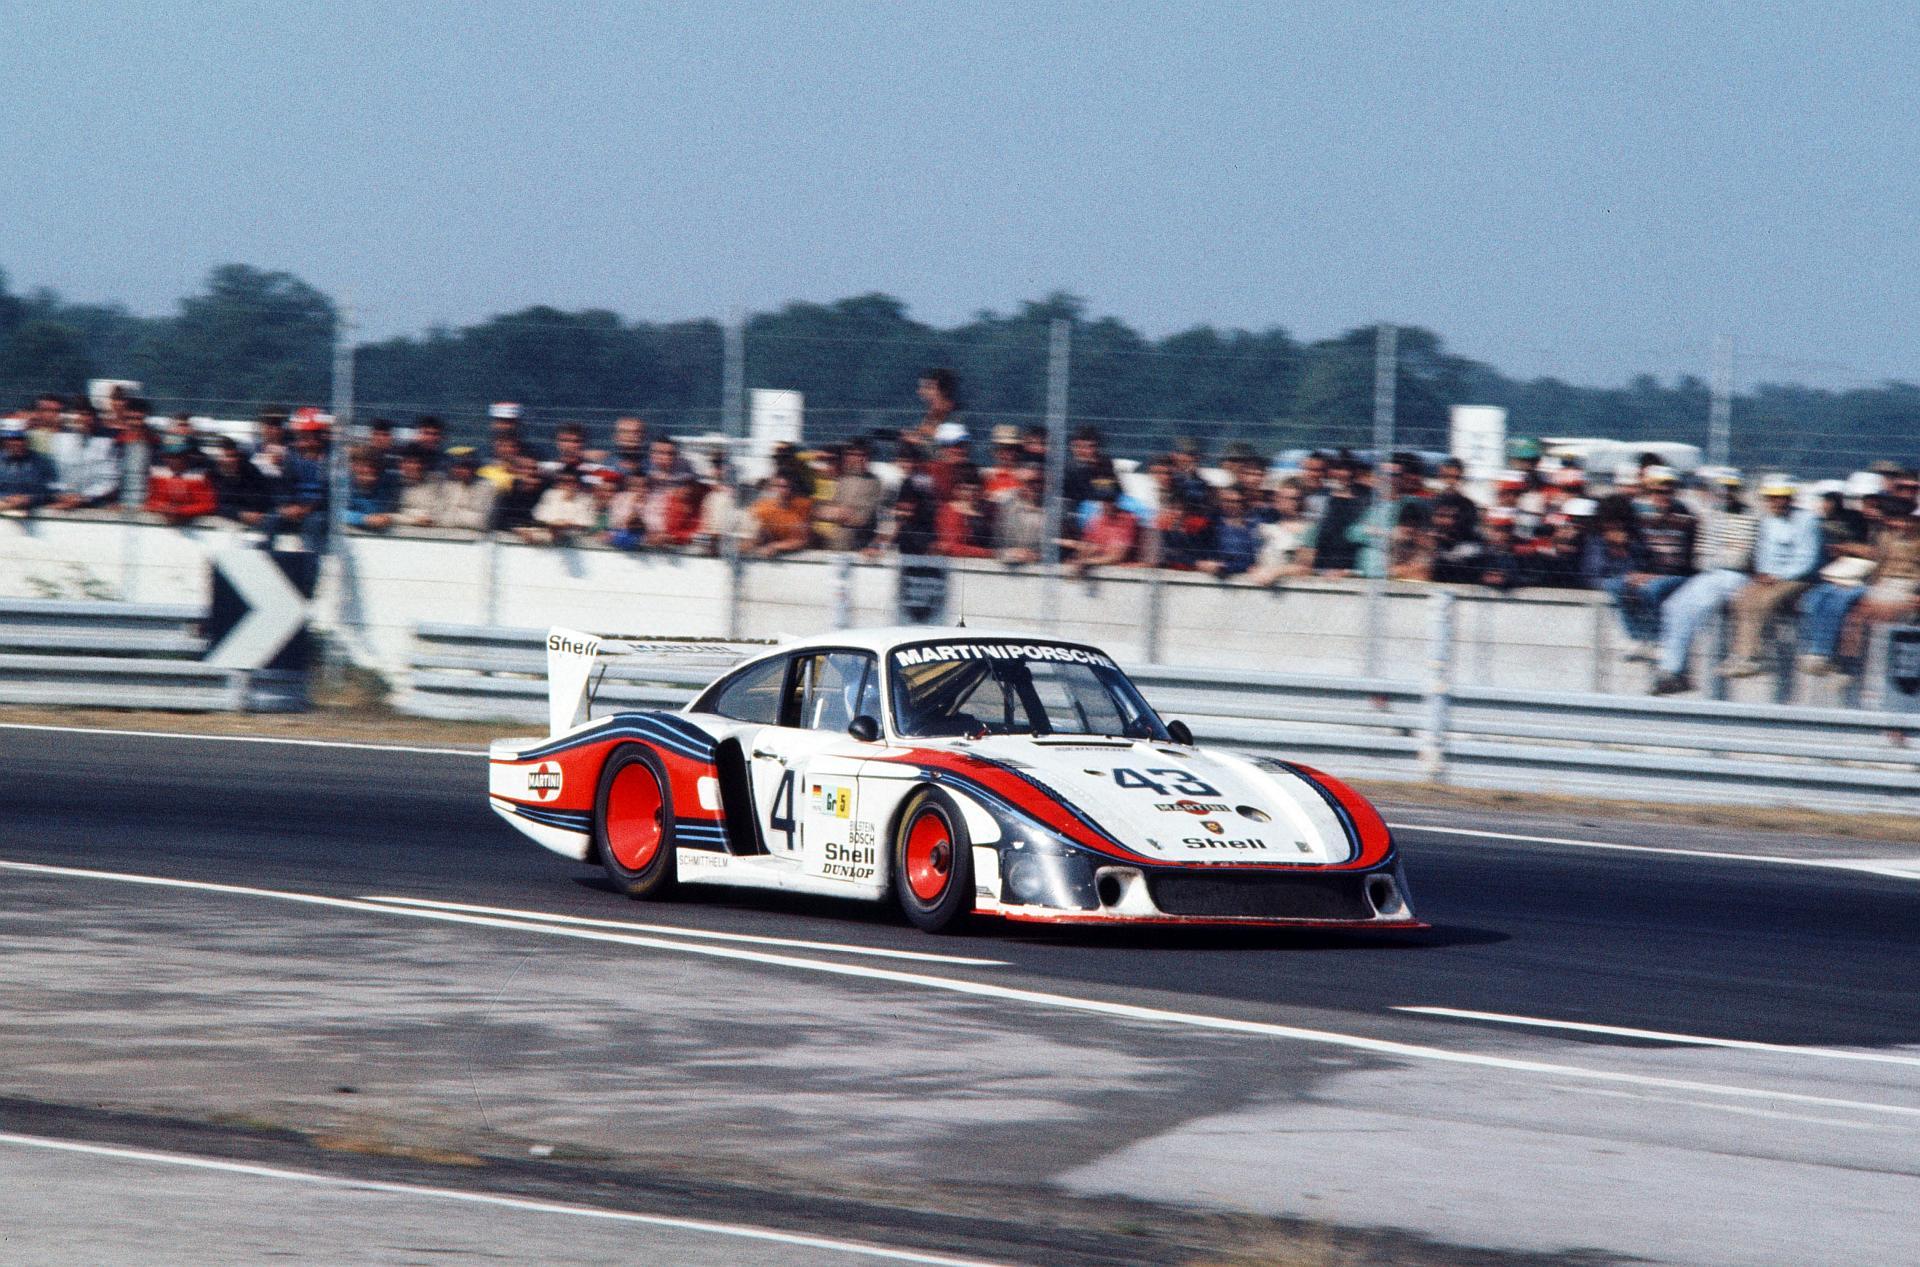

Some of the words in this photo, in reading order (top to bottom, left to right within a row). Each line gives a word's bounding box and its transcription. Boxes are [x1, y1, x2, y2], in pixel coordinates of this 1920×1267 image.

[549, 634, 598, 656] Shell
[528, 773, 561, 789] MARTINI
[1113, 768, 1222, 796] 43
[827, 793, 837, 811] Gr
[840, 794, 846, 812] 5
[1154, 803, 1232, 812] MARTINI
[849, 832, 875, 846] BOSCH
[1182, 838, 1267, 849] Shell
[825, 842, 875, 865] Shell
[822, 863, 875, 879] DUNLOP
